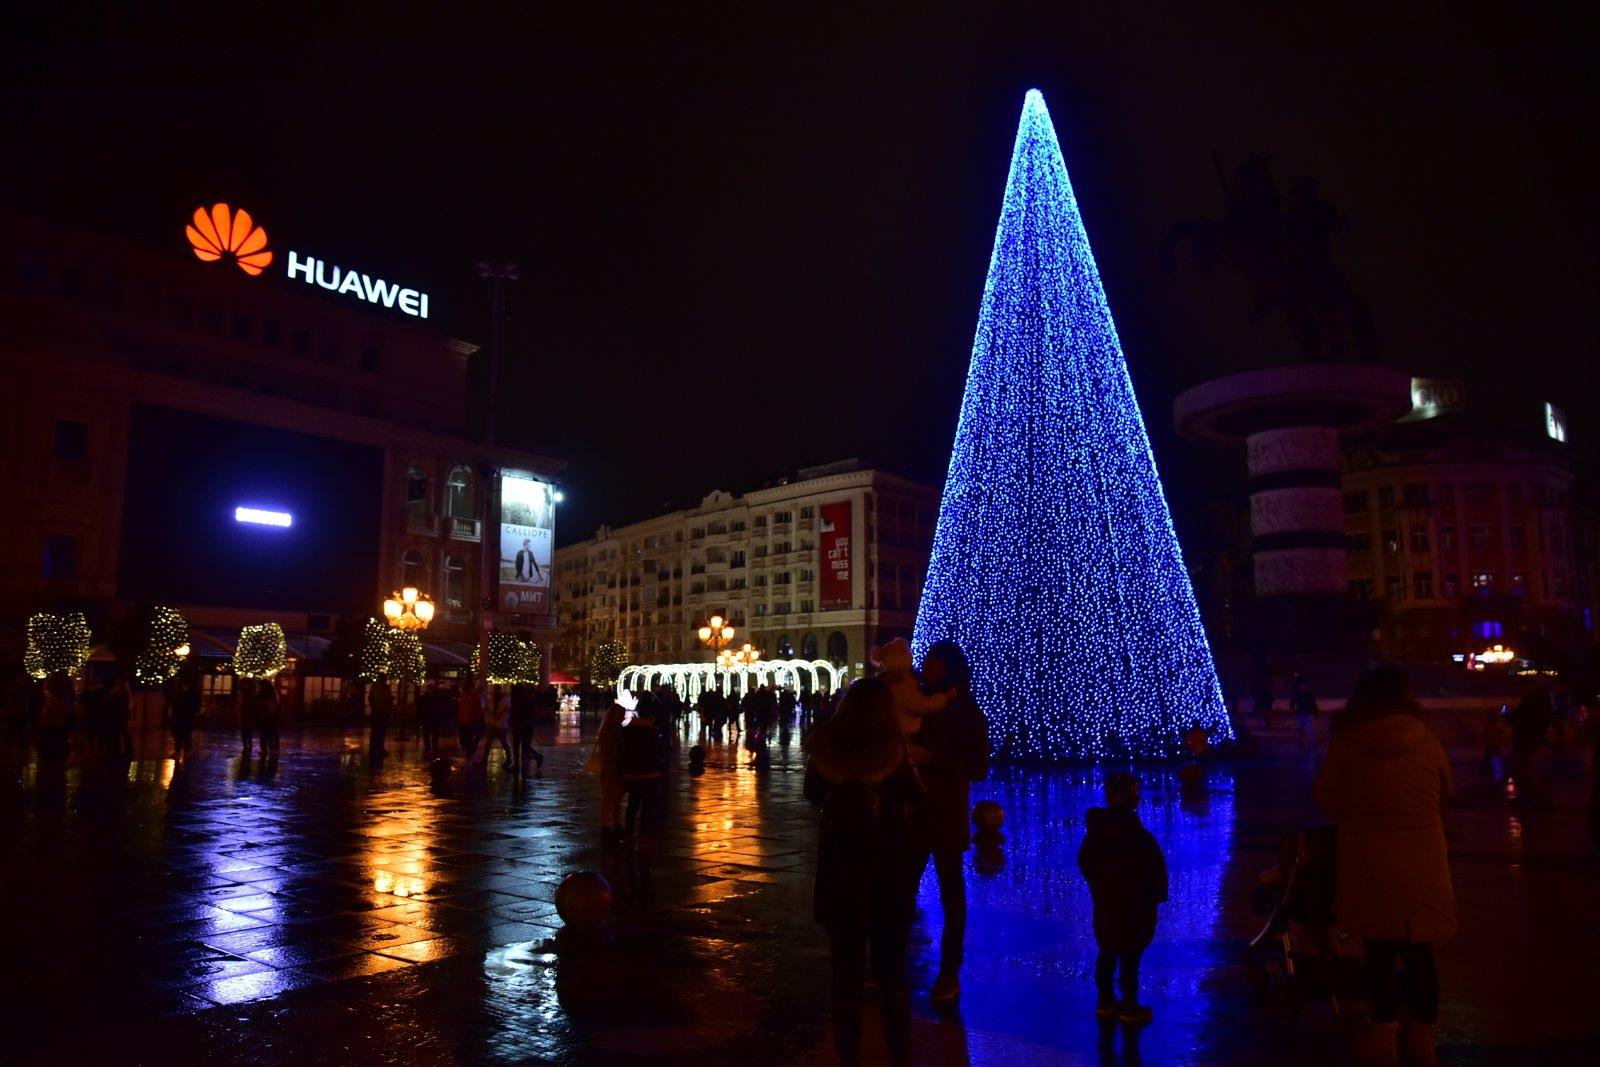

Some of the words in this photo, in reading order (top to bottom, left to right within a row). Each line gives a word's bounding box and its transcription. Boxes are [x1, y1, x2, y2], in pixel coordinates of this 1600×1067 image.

[287, 251, 429, 319] HUAWEI
[505, 525, 549, 539] CALLIOPE
[835, 537, 848, 548] you
[831, 559, 848, 570] miss
[837, 570, 848, 580] me
[520, 590, 543, 603] МИТ
